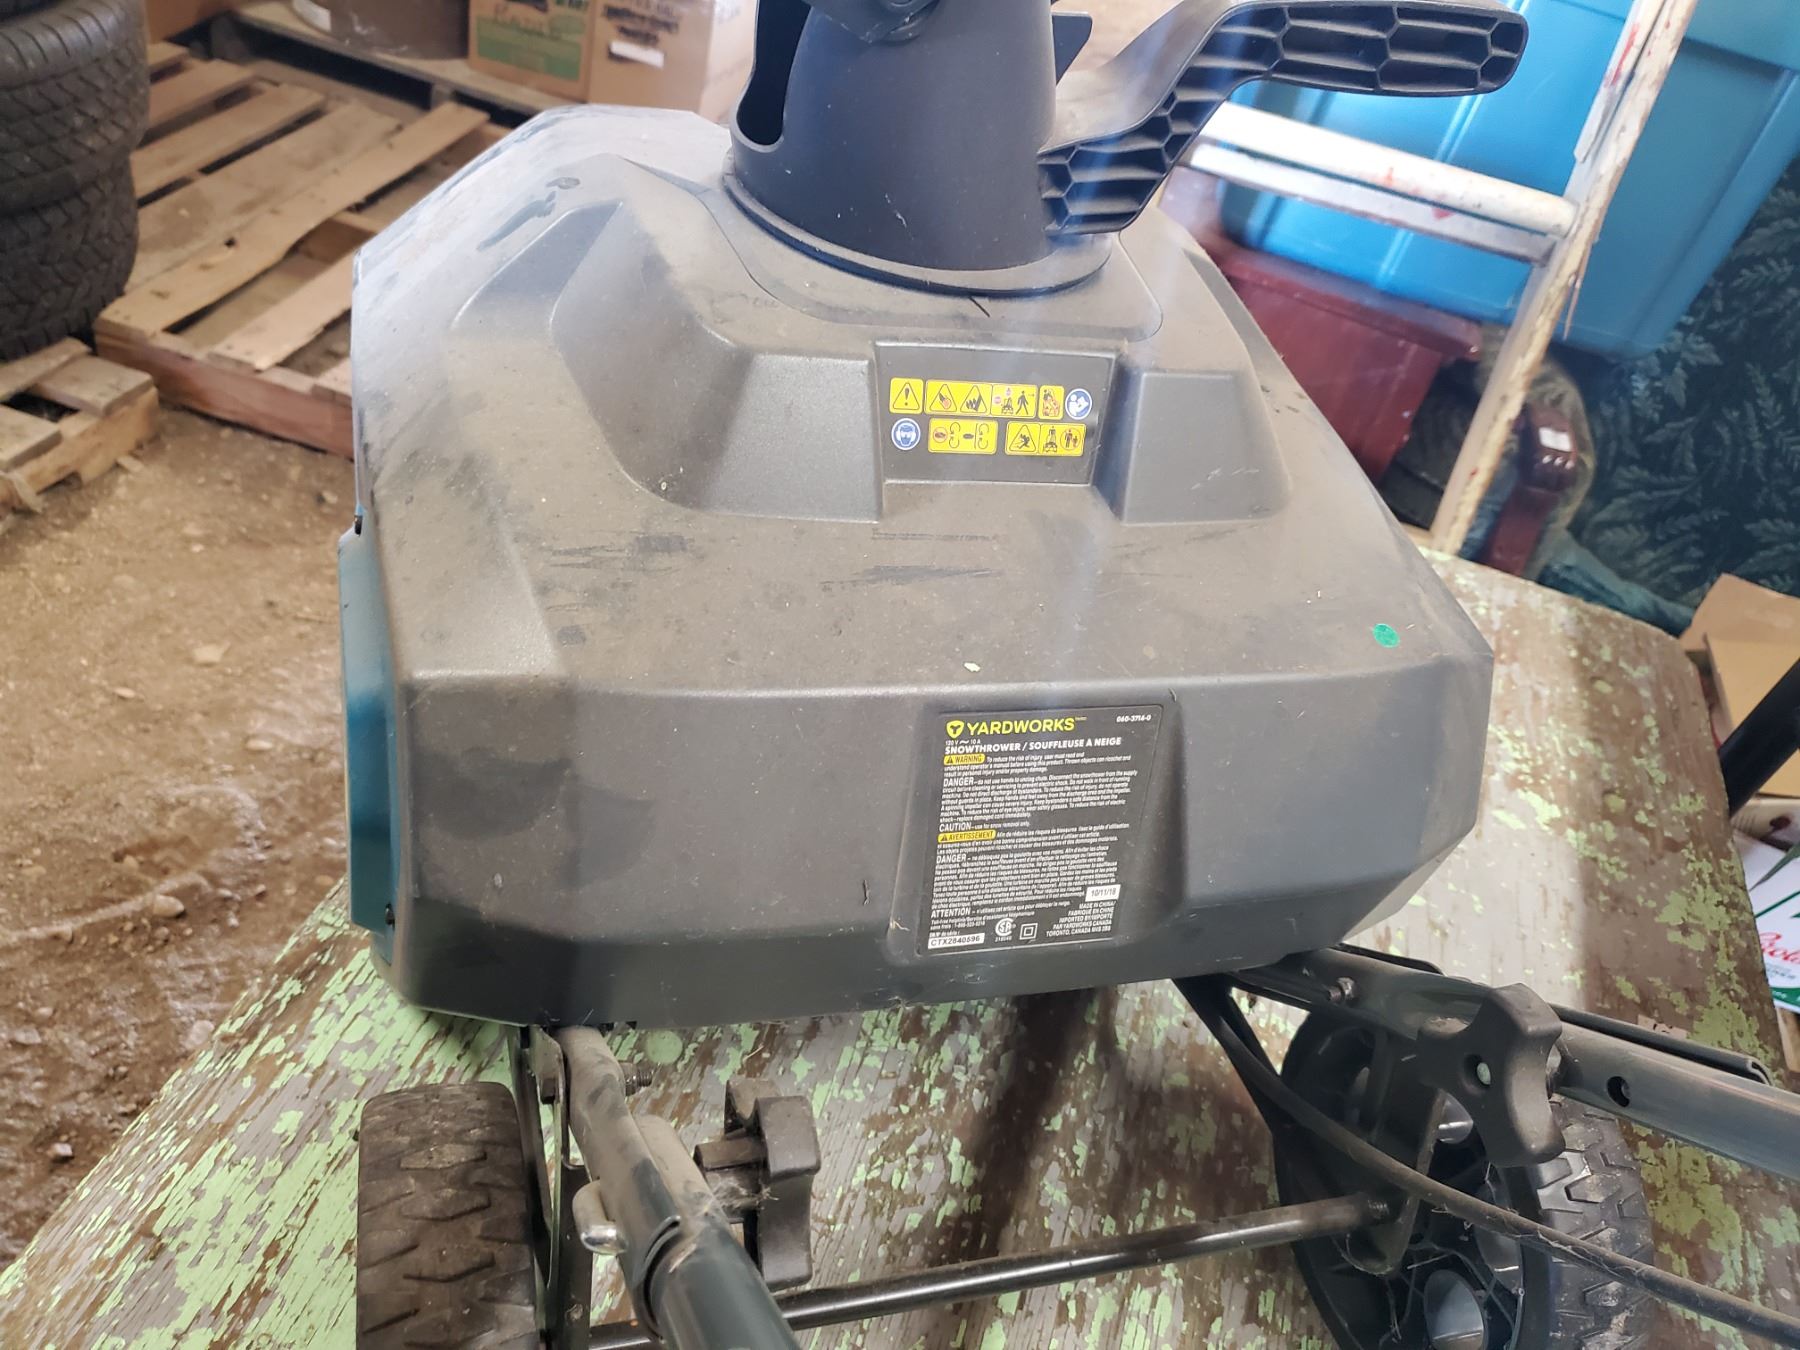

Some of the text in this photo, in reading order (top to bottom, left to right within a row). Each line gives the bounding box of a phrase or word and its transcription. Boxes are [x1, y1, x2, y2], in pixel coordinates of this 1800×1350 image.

[967, 718, 1075, 736] YARDWORKS
[945, 743, 1020, 754] SNOWTHROWER
[1023, 742, 1027, 750] /
[1029, 739, 1084, 750] SOUFFLEUSE
[1094, 737, 1122, 746] NEIGE
[954, 755, 982, 763] WARNING
[949, 831, 993, 840] AVERTISSEMENT
[937, 854, 967, 863] DANGER
[931, 907, 971, 918] ATTENTION
